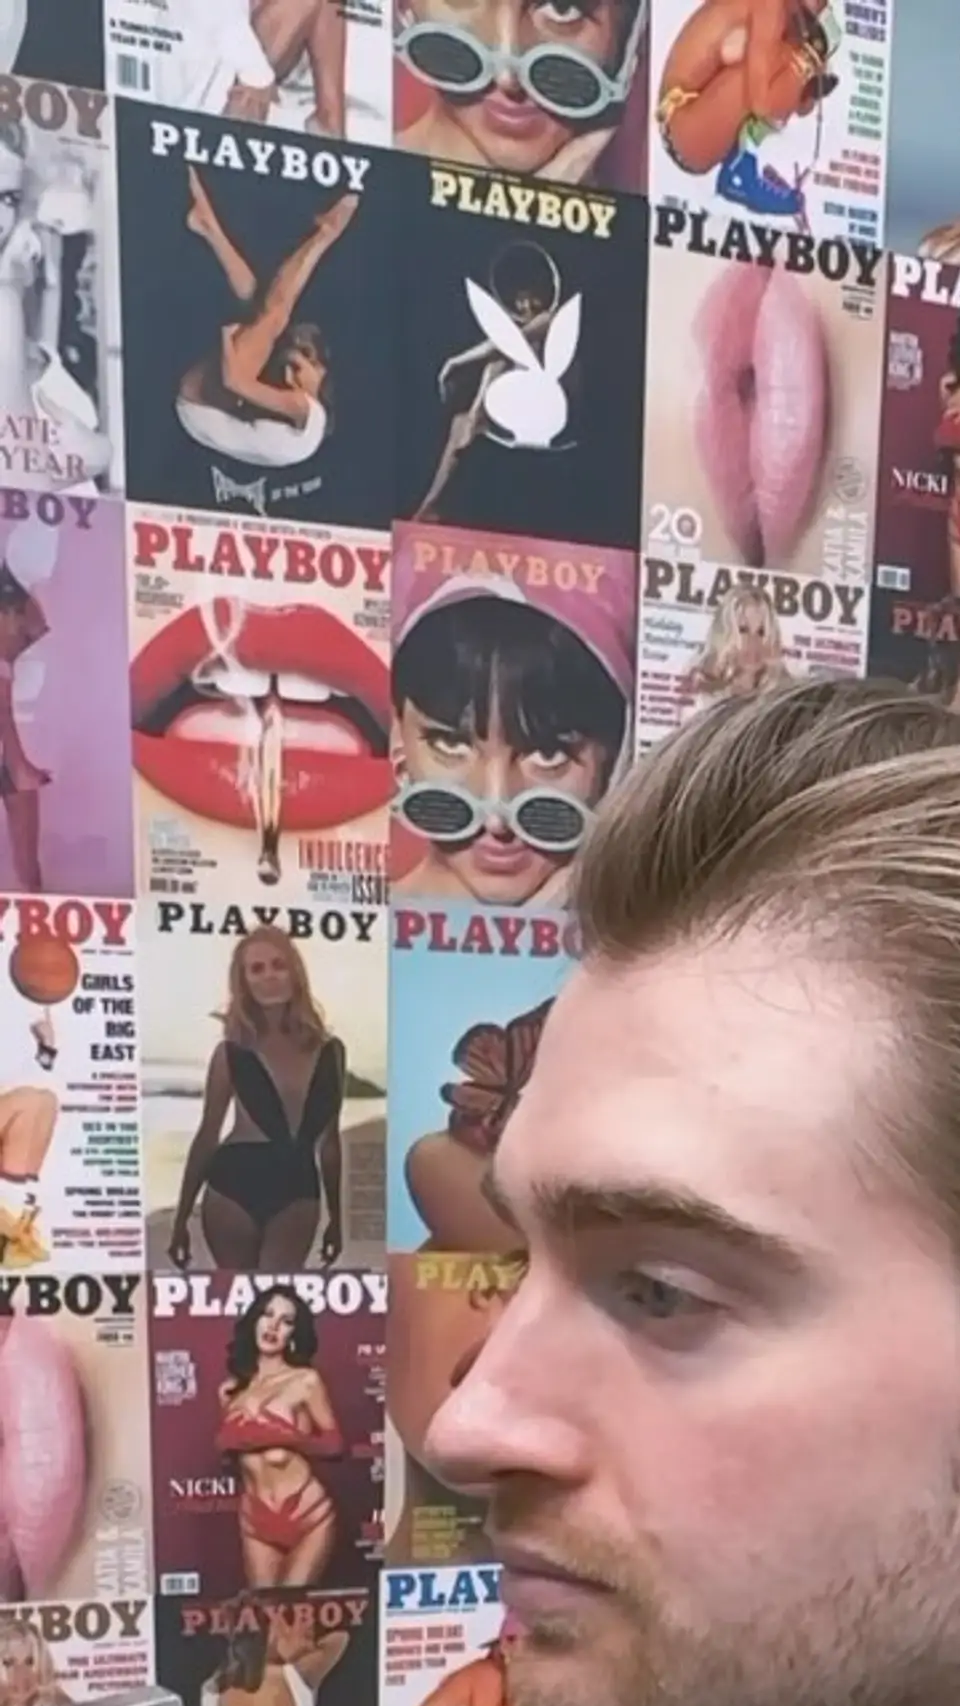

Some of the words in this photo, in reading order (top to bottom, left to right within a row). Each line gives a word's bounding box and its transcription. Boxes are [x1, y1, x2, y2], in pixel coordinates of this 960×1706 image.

[151, 120, 371, 192] PLAYBOY
[429, 169, 616, 239] PLAYBOY
[653, 205, 883, 288] PLAYBOY
[891, 468, 948, 494] NICKI
[133, 521, 391, 592] PLAYBOY
[412, 541, 605, 595] PLAYBOY
[0, 899, 132, 946] BOY
[157, 902, 378, 942] PLAYBOY
[81, 974, 134, 992] GIRLS
[72, 998, 95, 1014] OF
[100, 998, 135, 1015] THE
[105, 1021, 135, 1038] BIG
[90, 1044, 135, 1061] EAST
[168, 1476, 236, 1498] NICKI
[181, 1600, 369, 1637] PLAYBOY
